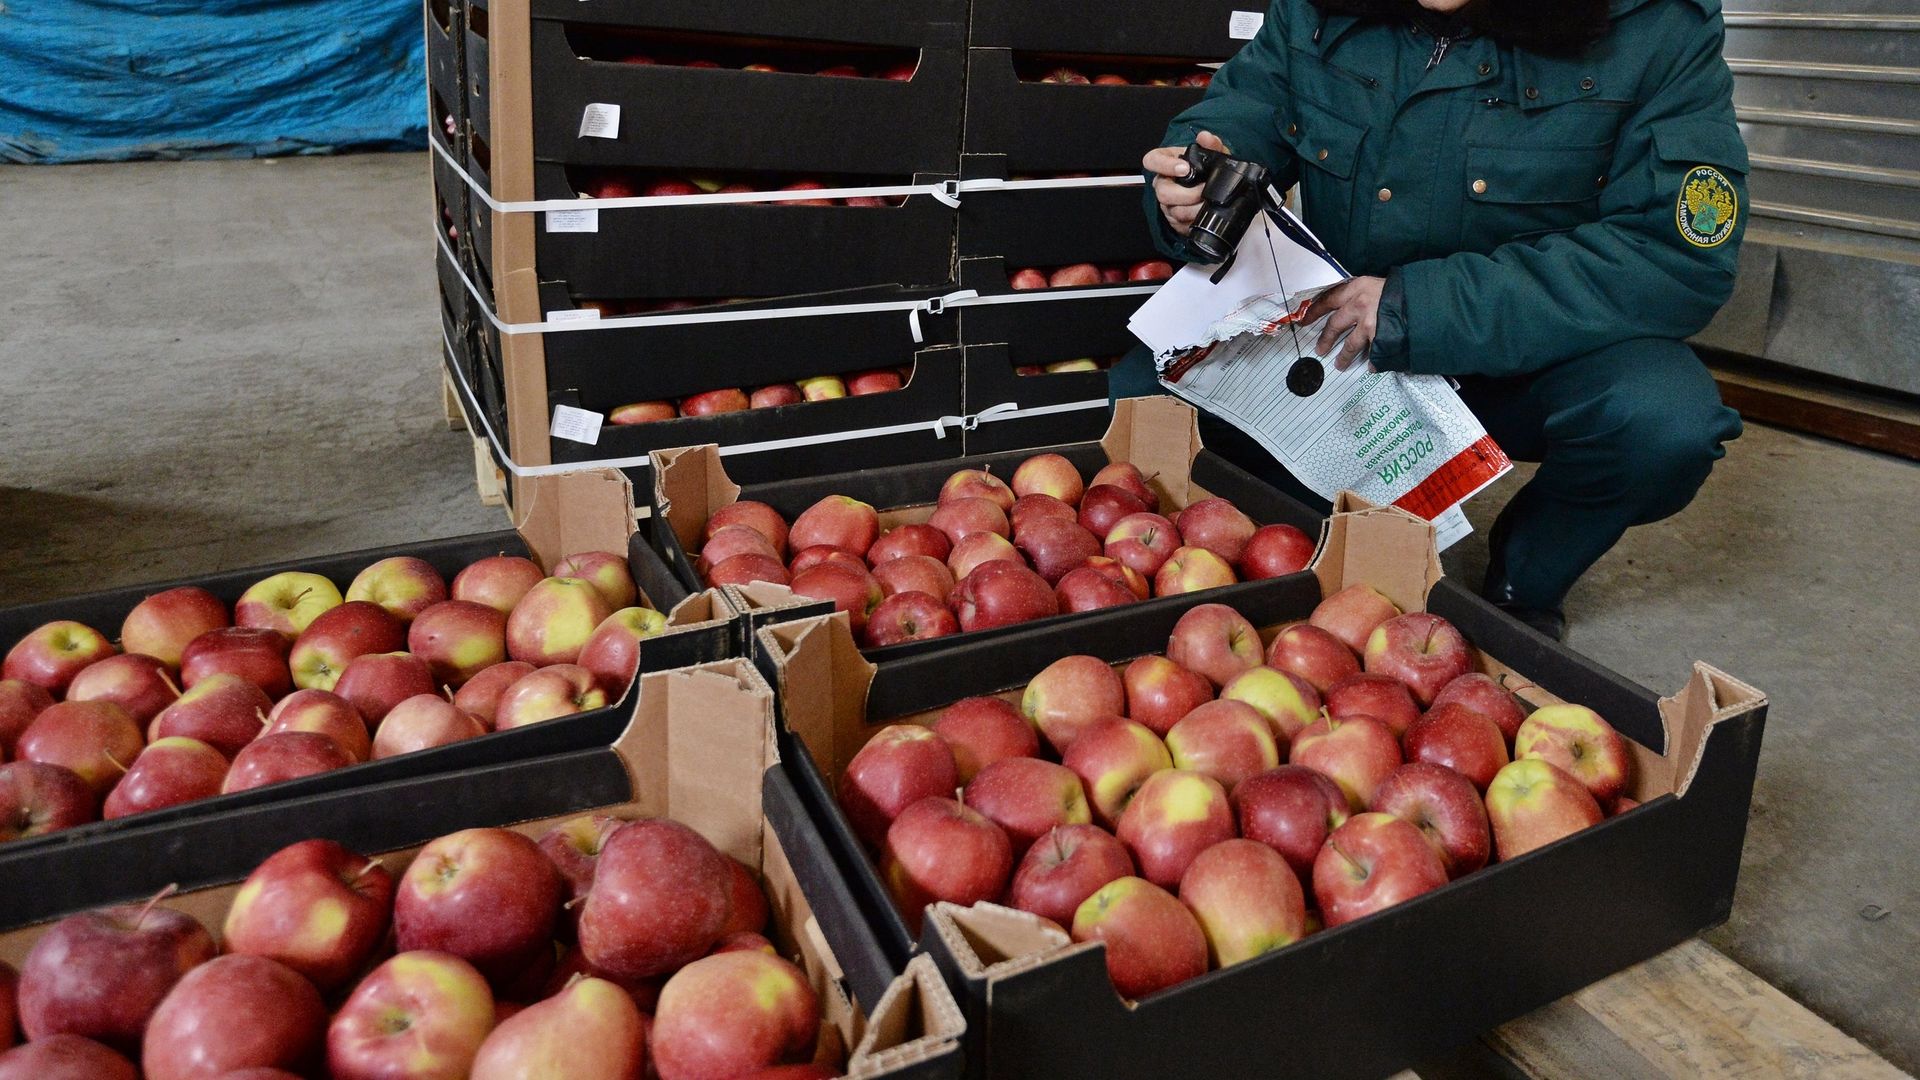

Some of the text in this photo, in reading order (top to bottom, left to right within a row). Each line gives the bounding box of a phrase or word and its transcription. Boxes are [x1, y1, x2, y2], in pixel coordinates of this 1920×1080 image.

[1695, 169, 1728, 187] РОССИЯ
[1679, 200, 1733, 244] ТАМОЖЕННАЯ СЛУЖБА
[1353, 404, 1391, 440] служба
[1377, 433, 1435, 485] РОССИЯ
